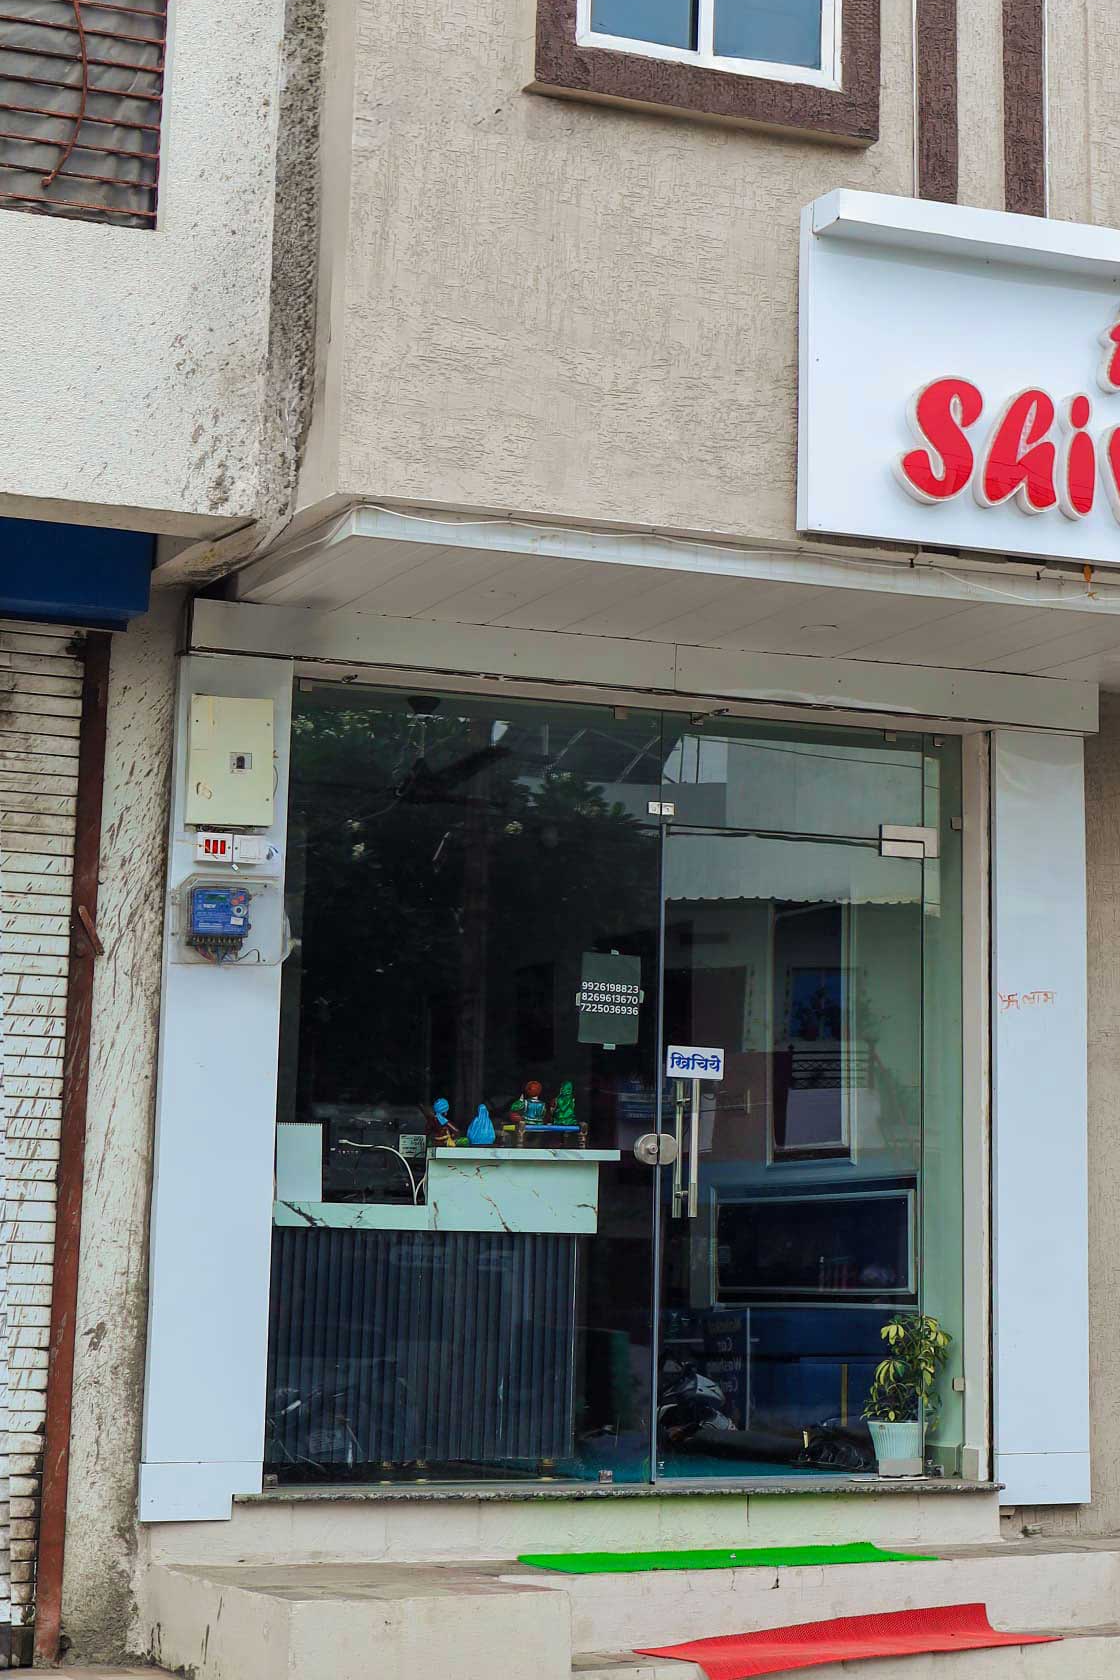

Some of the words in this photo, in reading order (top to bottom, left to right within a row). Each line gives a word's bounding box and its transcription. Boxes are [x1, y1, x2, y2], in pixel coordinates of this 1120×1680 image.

[582, 981, 639, 994] 9926198823
[581, 992, 638, 1005] 8269613670
[580, 1003, 639, 1016] 7225036936
